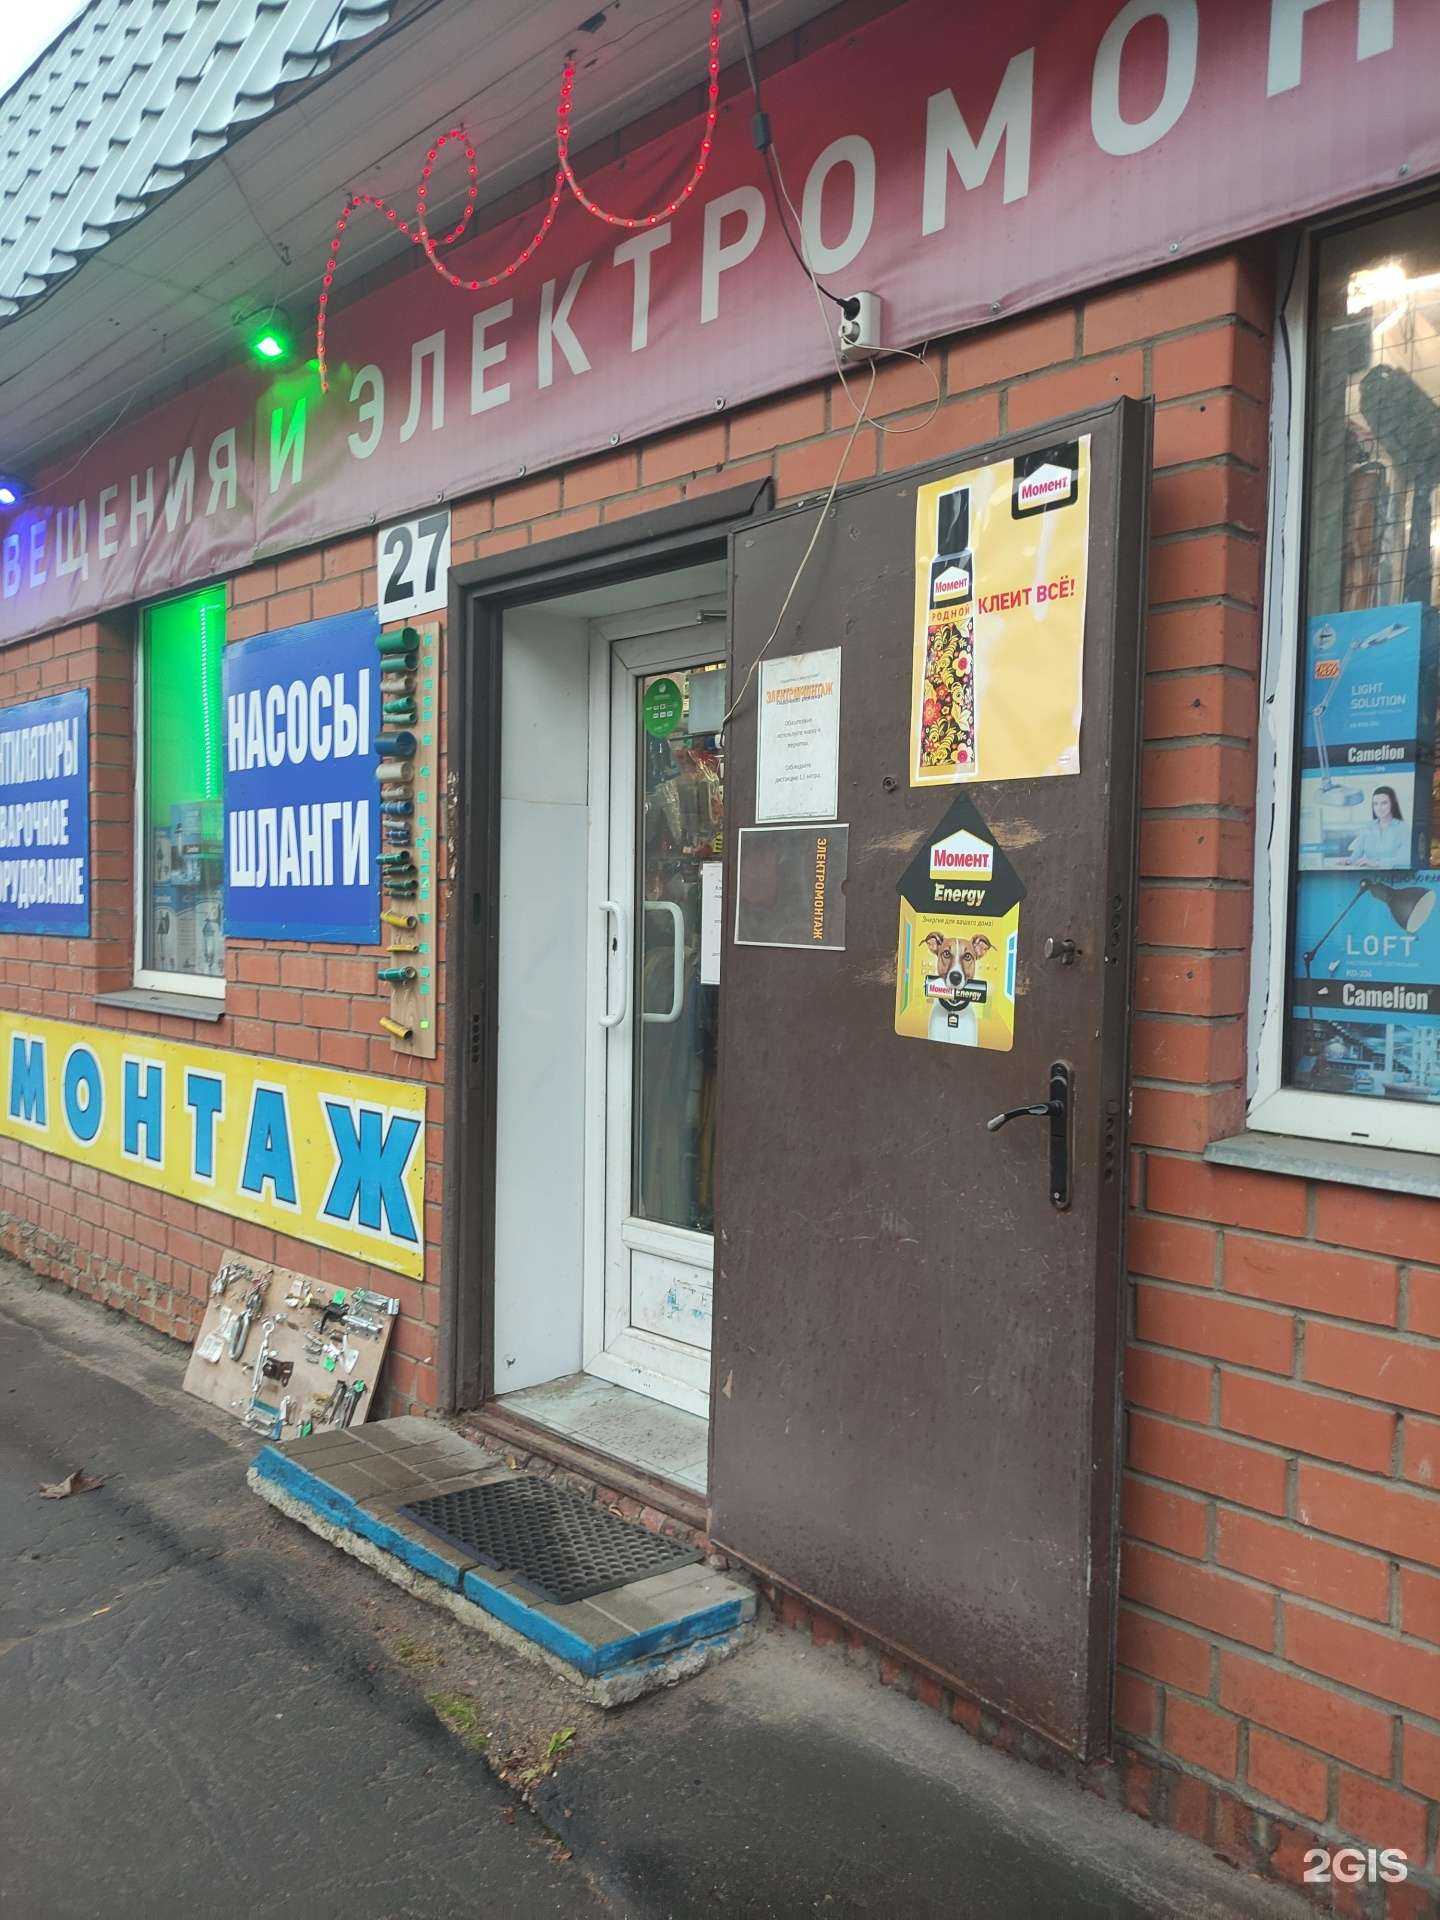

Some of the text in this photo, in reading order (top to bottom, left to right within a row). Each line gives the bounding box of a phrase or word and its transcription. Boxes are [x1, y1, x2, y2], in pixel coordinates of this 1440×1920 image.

[269, 398, 307, 495] И
[1021, 477, 1068, 499] Момент
[384, 512, 449, 605] 27
[935, 578, 968, 593] Момент
[978, 575, 1075, 614] КЛЕИТ ВСЁ!
[1350, 694, 1407, 709] SOLUTION
[1351, 682, 1384, 696] LIGHT
[228, 669, 371, 772] НАСОСЫ
[1347, 744, 1405, 763] Camelion
[228, 799, 370, 888] ШЛАНГИ
[933, 849, 990, 868] Момент
[813, 838, 828, 940] ЭЛЕКТРОМОНТАЖ
[934, 883, 986, 907] Energy
[1346, 934, 1417, 957] LOFT
[1342, 983, 1429, 1011] Camelion
[8, 1031, 424, 1253] МОНТАЖ
